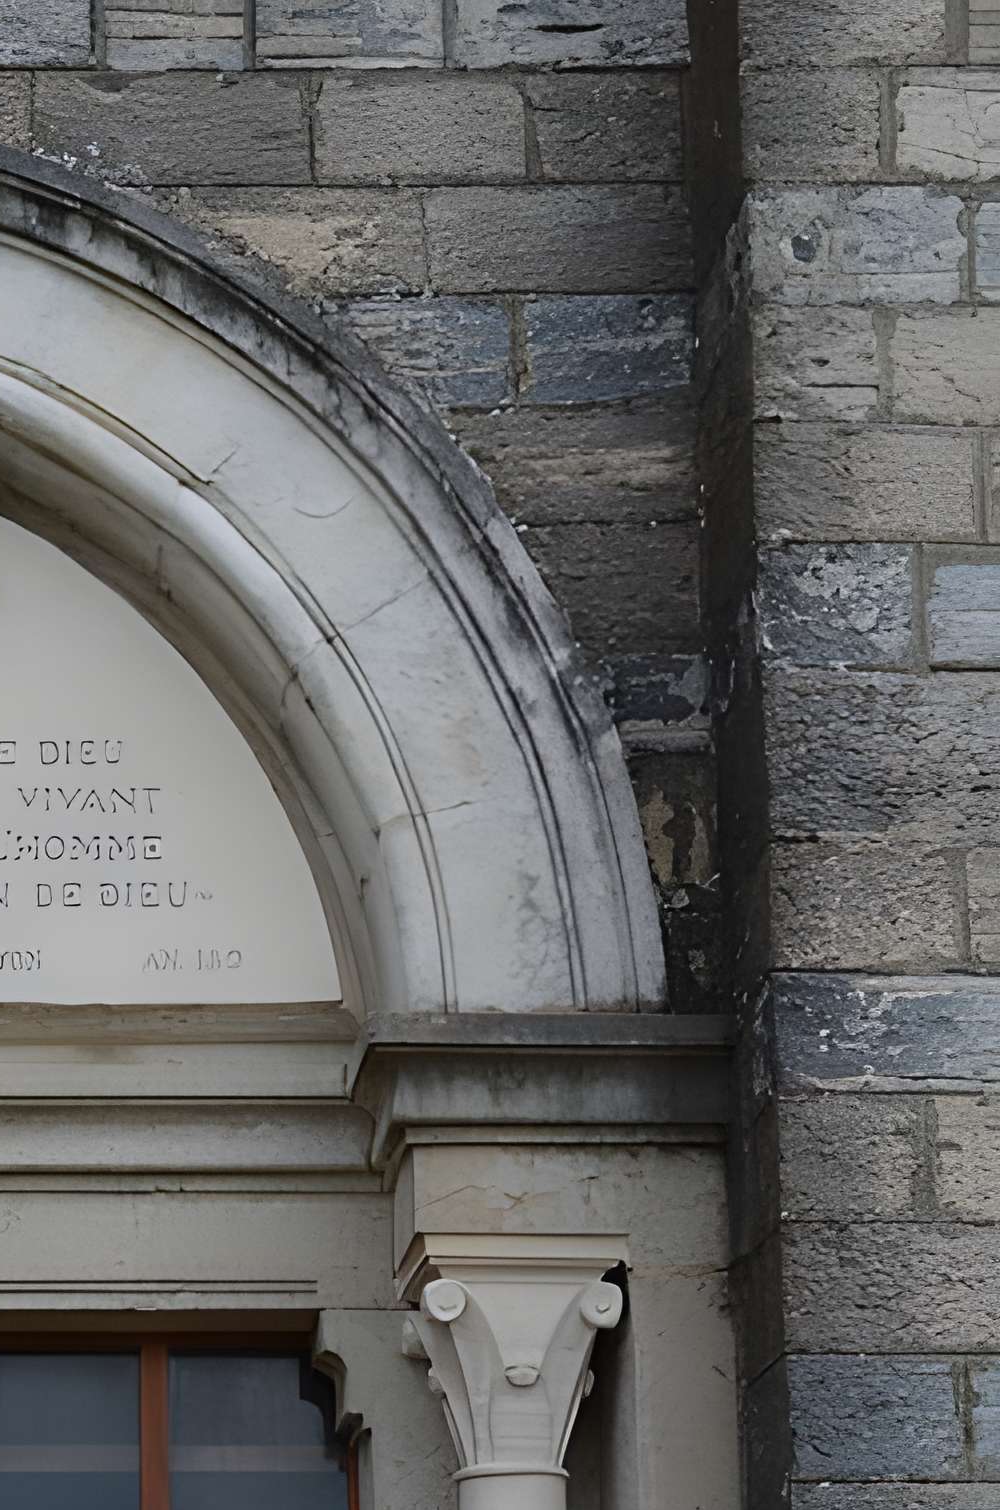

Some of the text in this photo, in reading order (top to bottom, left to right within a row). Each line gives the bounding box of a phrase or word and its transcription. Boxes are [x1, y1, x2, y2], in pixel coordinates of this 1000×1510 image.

[39, 740, 122, 765] DIEU
[17, 787, 161, 814] VIVANT
[36, 882, 82, 907] DE
